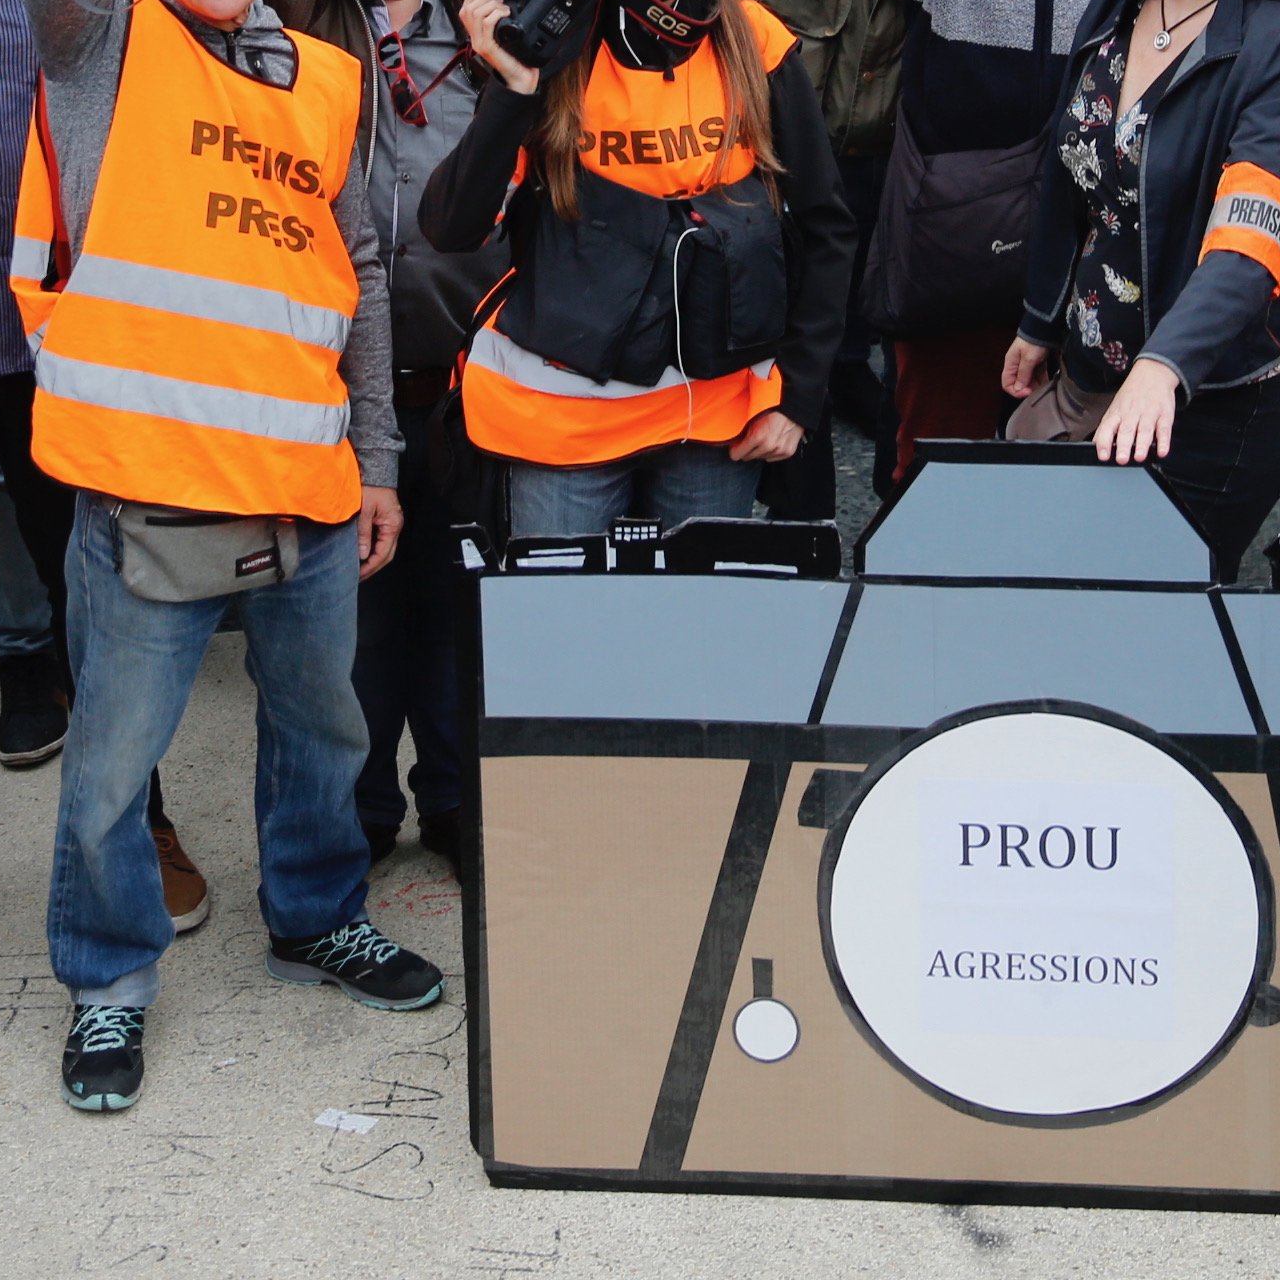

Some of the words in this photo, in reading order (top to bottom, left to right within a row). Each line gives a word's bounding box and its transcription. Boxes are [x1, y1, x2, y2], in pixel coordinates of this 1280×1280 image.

[646, 5, 692, 37] EOS
[191, 119, 326, 200] PREMS
[241, 555, 273, 570] EASTPAK
[958, 822, 1121, 871] PROU
[926, 949, 1159, 987] AGRESSIONS
